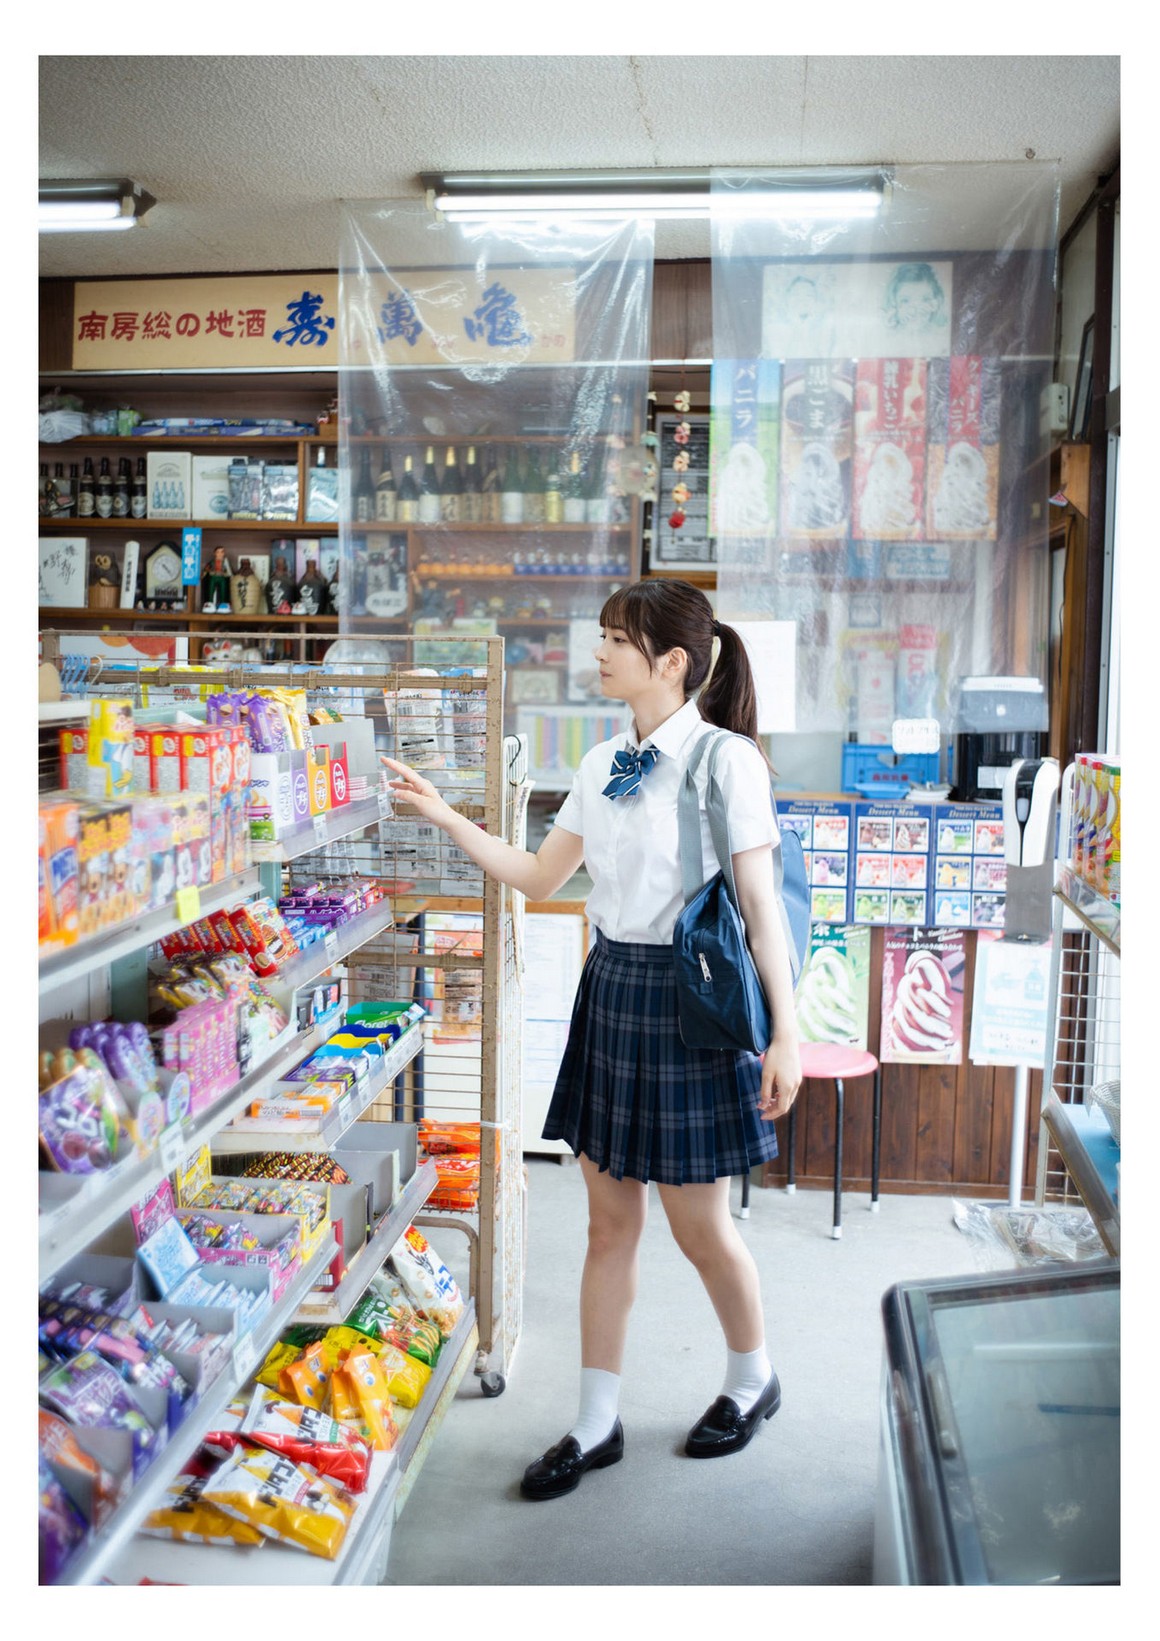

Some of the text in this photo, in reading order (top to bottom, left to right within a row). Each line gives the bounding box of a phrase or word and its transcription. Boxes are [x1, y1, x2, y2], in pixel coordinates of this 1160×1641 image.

[77, 309, 267, 342] 南房総の地酒
[734, 362, 759, 429] バニラ
[807, 362, 832, 430] 黒ごま
